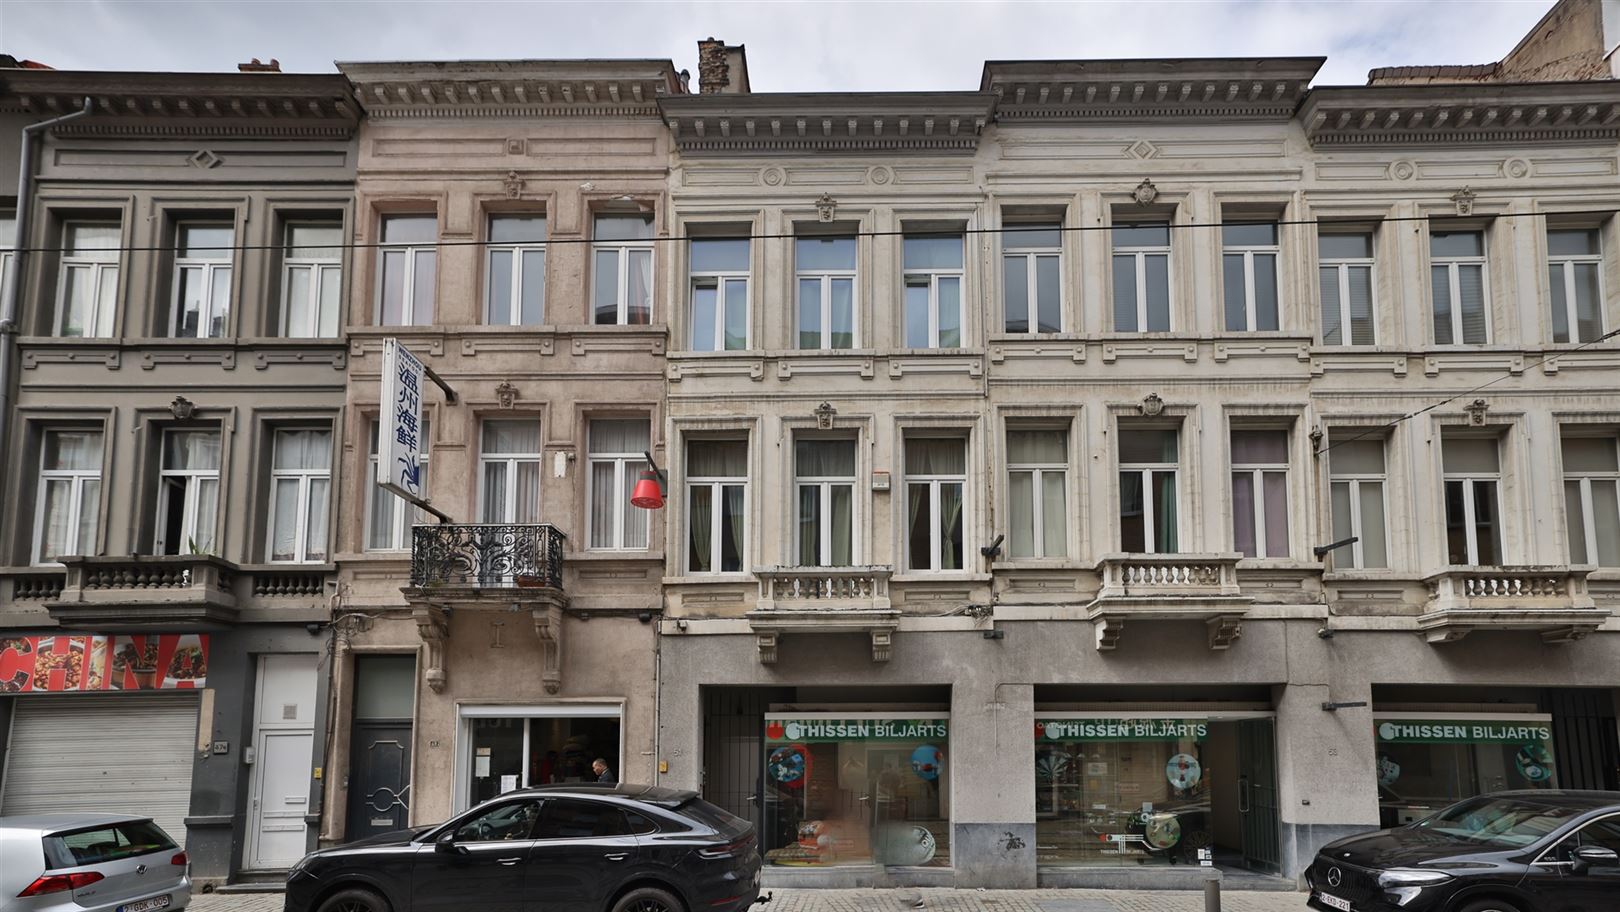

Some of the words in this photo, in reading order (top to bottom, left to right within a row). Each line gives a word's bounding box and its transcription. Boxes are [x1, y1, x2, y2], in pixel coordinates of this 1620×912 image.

[0, 635, 208, 693] CHINA
[799, 725, 869, 737] THISSEN
[875, 725, 947, 737] BILJARTS
[1058, 725, 1129, 737] THISSEN
[1135, 725, 1207, 737] BILJARTS
[1393, 725, 1467, 738] THISSEN
[1472, 726, 1550, 740] BILJARTS
